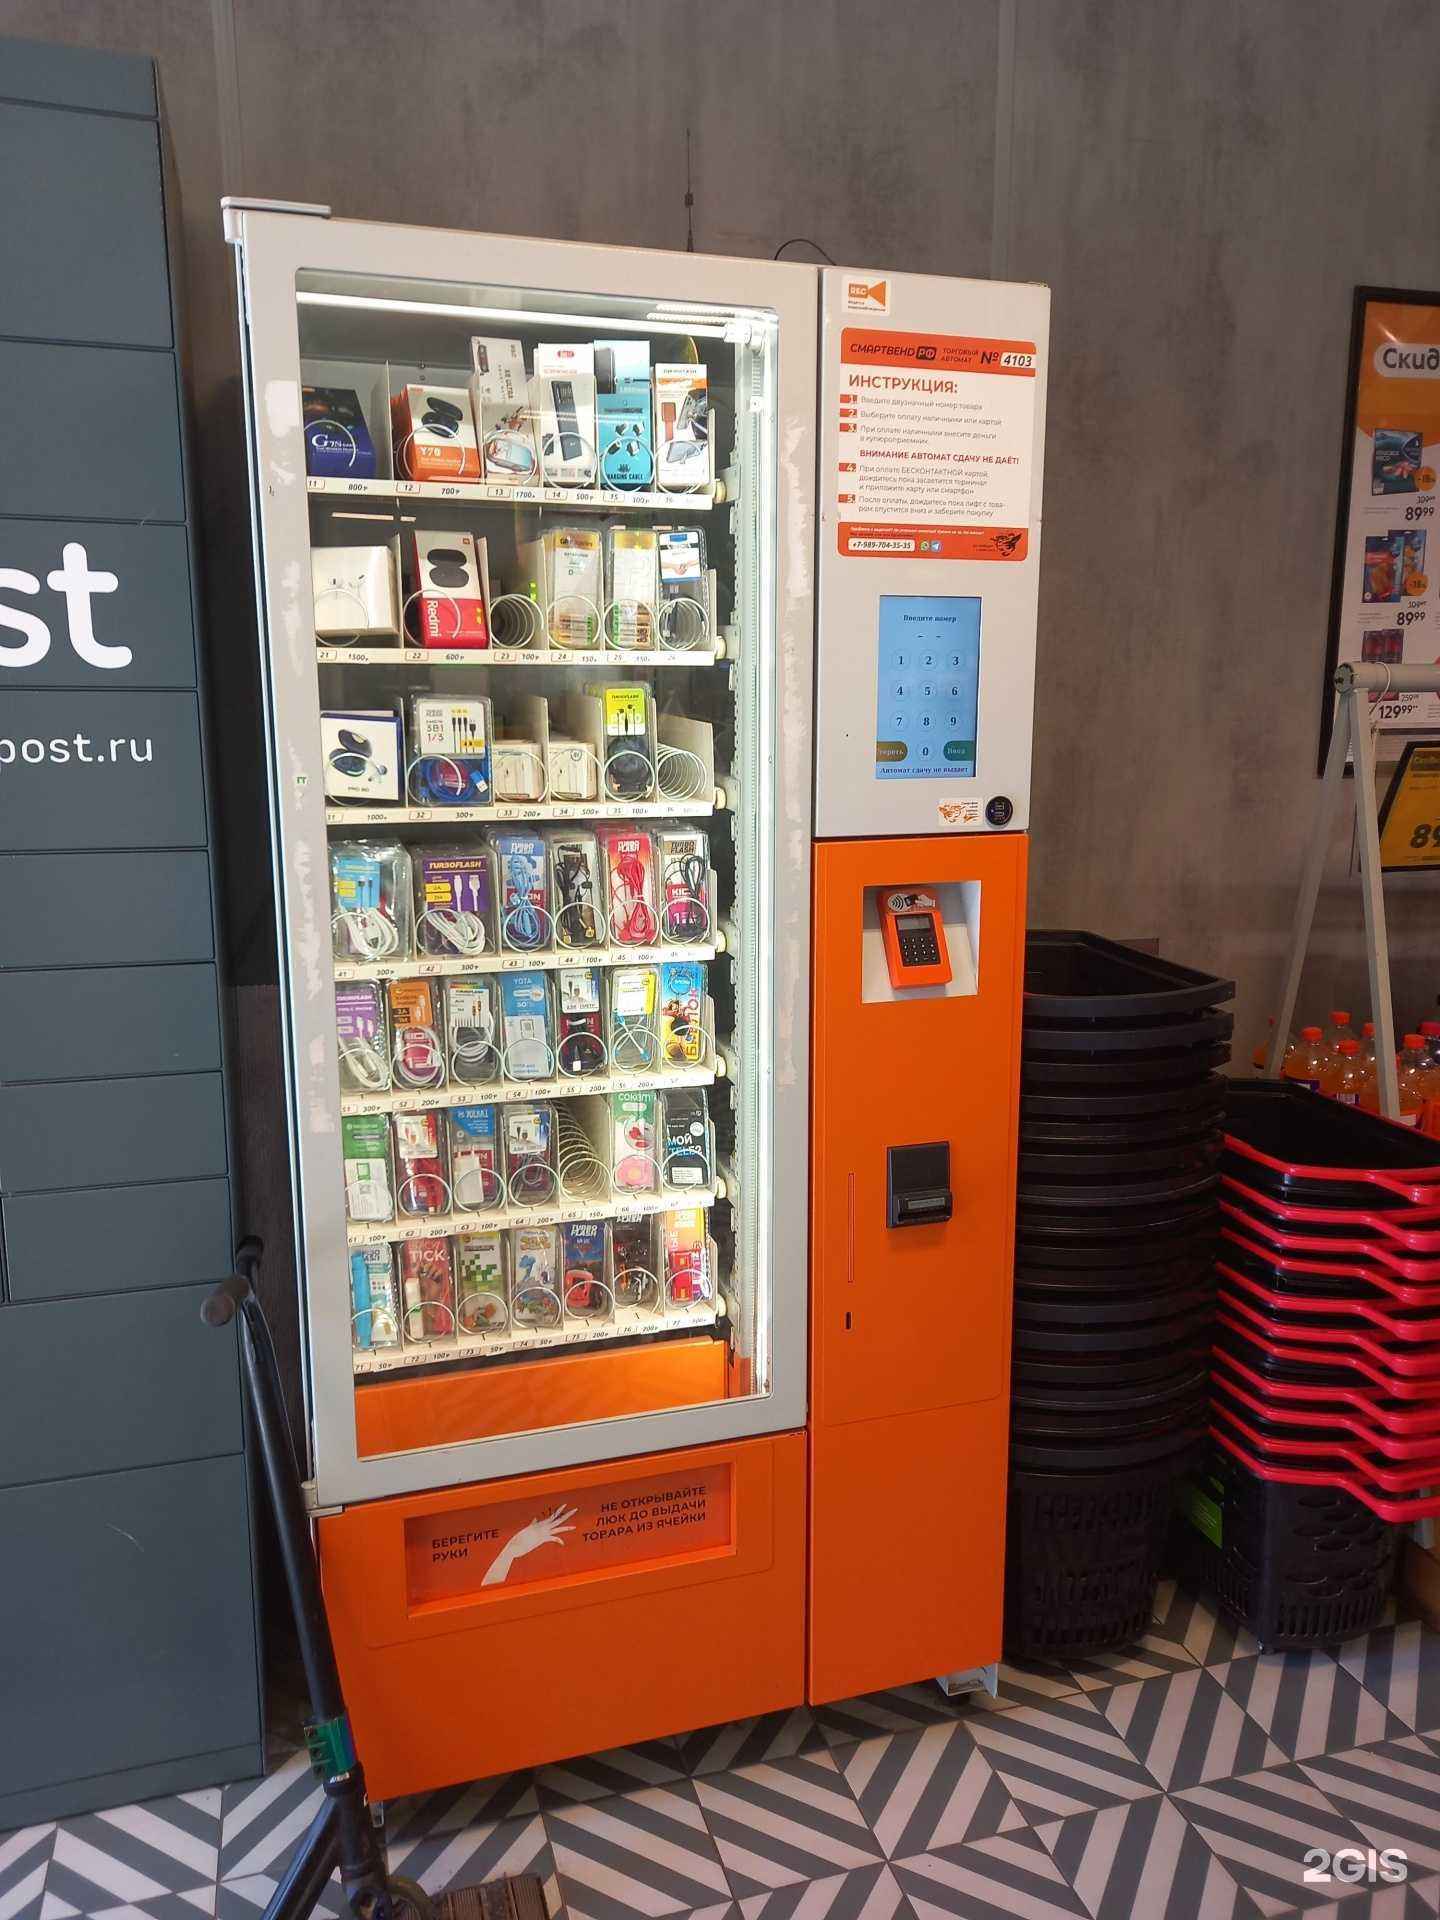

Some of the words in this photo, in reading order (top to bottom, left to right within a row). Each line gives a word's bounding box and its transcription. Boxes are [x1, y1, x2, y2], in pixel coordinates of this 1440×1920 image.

[1004, 354, 1032, 367] 4103
[848, 374, 958, 394] ИНСТРУКЦИЯ:
[861, 410, 896, 421] Выберите
[860, 449, 910, 459] ВНИМАНИЕ
[911, 452, 952, 461] АВТОМАТ
[952, 454, 981, 463] СДАЧУ
[982, 456, 994, 464] НЕ
[901, 466, 964, 477] БЕСКОНТАКТНОЙ
[852, 540, 912, 550] +7-989-704-35-35
[426, 600, 442, 638] Redmi
[898, 656, 904, 665] 1
[925, 656, 933, 665] 2
[952, 656, 960, 666] 3
[896, 686, 904, 696] 4
[924, 686, 931, 696] 5
[951, 686, 959, 696] 6
[896, 716, 903, 727] 7
[923, 717, 930, 727] 8
[950, 716, 957, 727] 9
[922, 746, 929, 757] 0
[601, 1502, 618, 1513] НЕ
[621, 1486, 707, 1509] ОТКРЫВАЙТЕ
[596, 1513, 627, 1528] ЛЮК
[629, 1510, 649, 1522] ДО
[651, 1499, 707, 1517] ВЫДАЧИ
[636, 1521, 654, 1532] ИЗ
[656, 1511, 707, 1529] ЯЧЕЙКИ
[432, 1528, 500, 1549] БЕРЕГИТЕ
[432, 1548, 469, 1563] РУКИ
